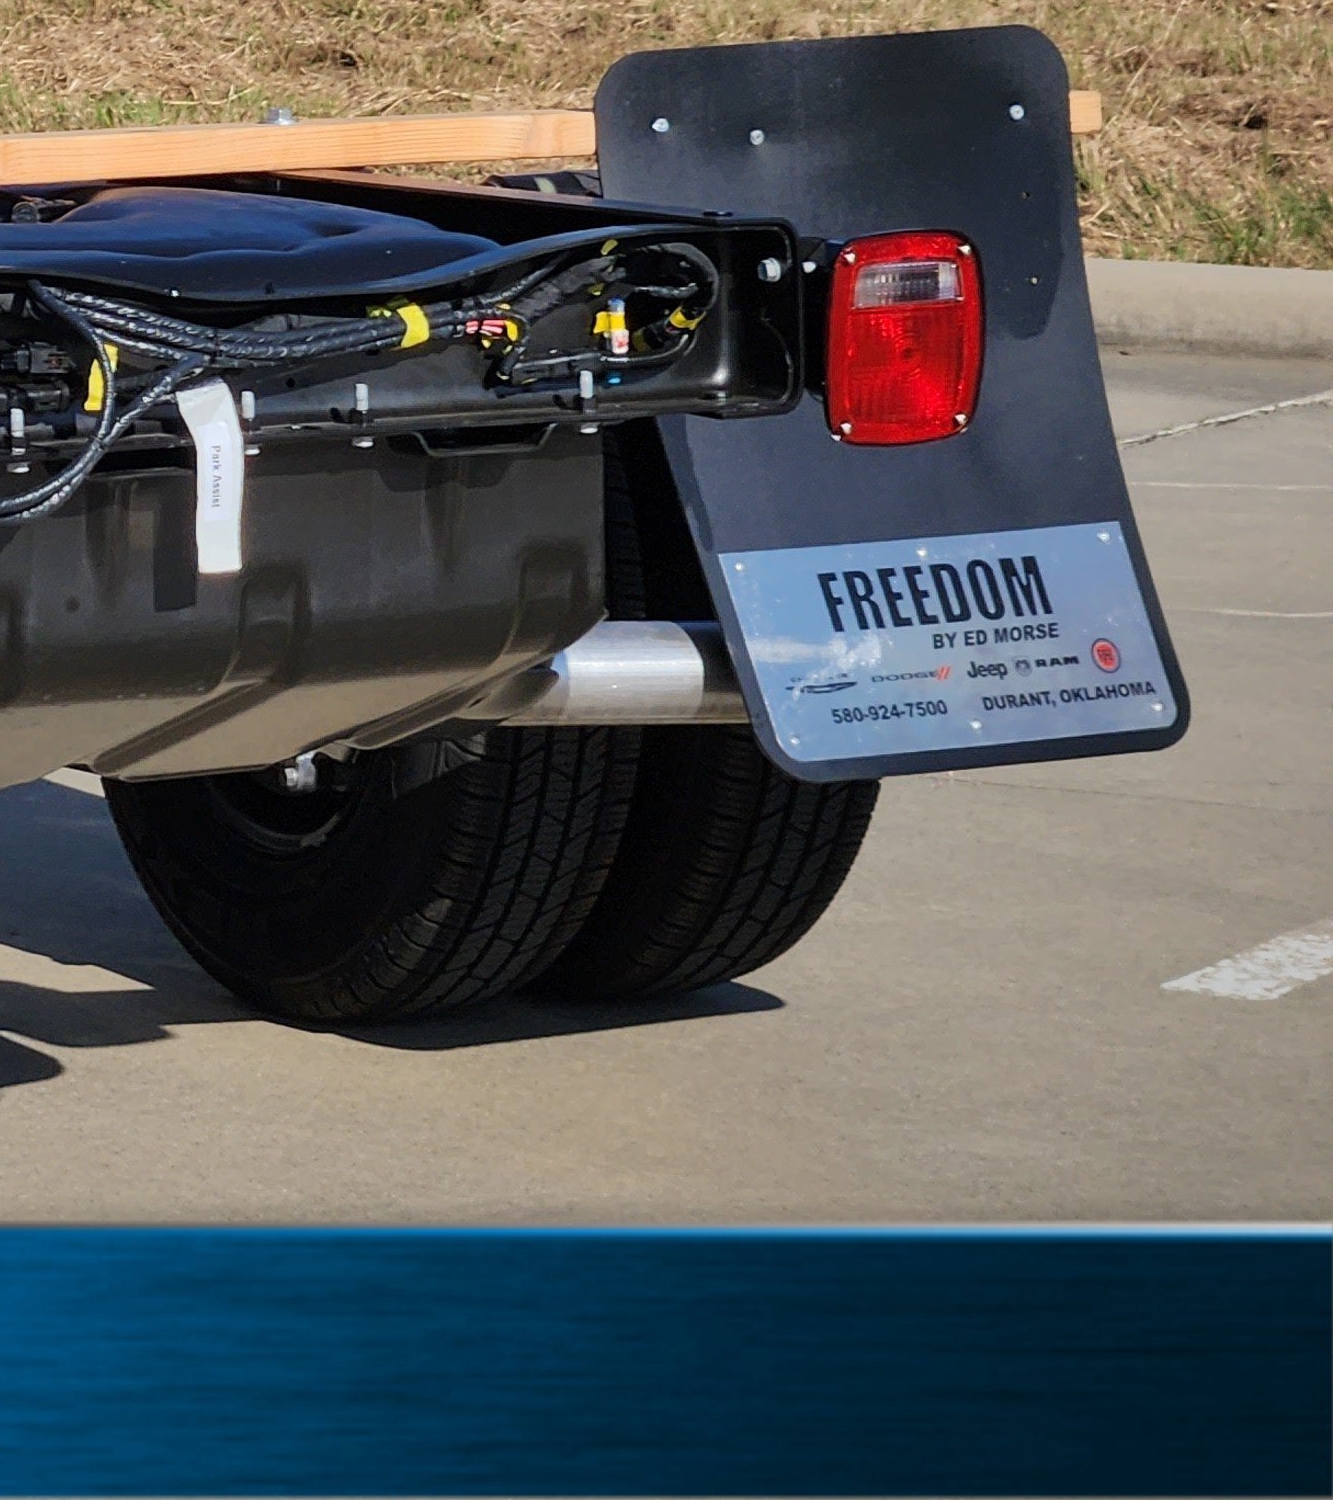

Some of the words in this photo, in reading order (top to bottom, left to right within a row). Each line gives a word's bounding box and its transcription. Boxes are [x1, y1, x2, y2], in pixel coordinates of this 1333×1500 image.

[210, 445, 221, 471] Park
[211, 474, 222, 508] Assist
[816, 555, 1054, 633] FREEDOM
[933, 632, 957, 650] BY
[963, 629, 988, 646] ED
[993, 622, 1060, 644] MORSE
[966, 660, 1009, 681] Jeep
[1035, 655, 1079, 668] RAM
[981, 690, 1057, 712] DURANT,
[1059, 680, 1157, 704] OKLAHOMA
[831, 699, 949, 725] 580-924-7500
